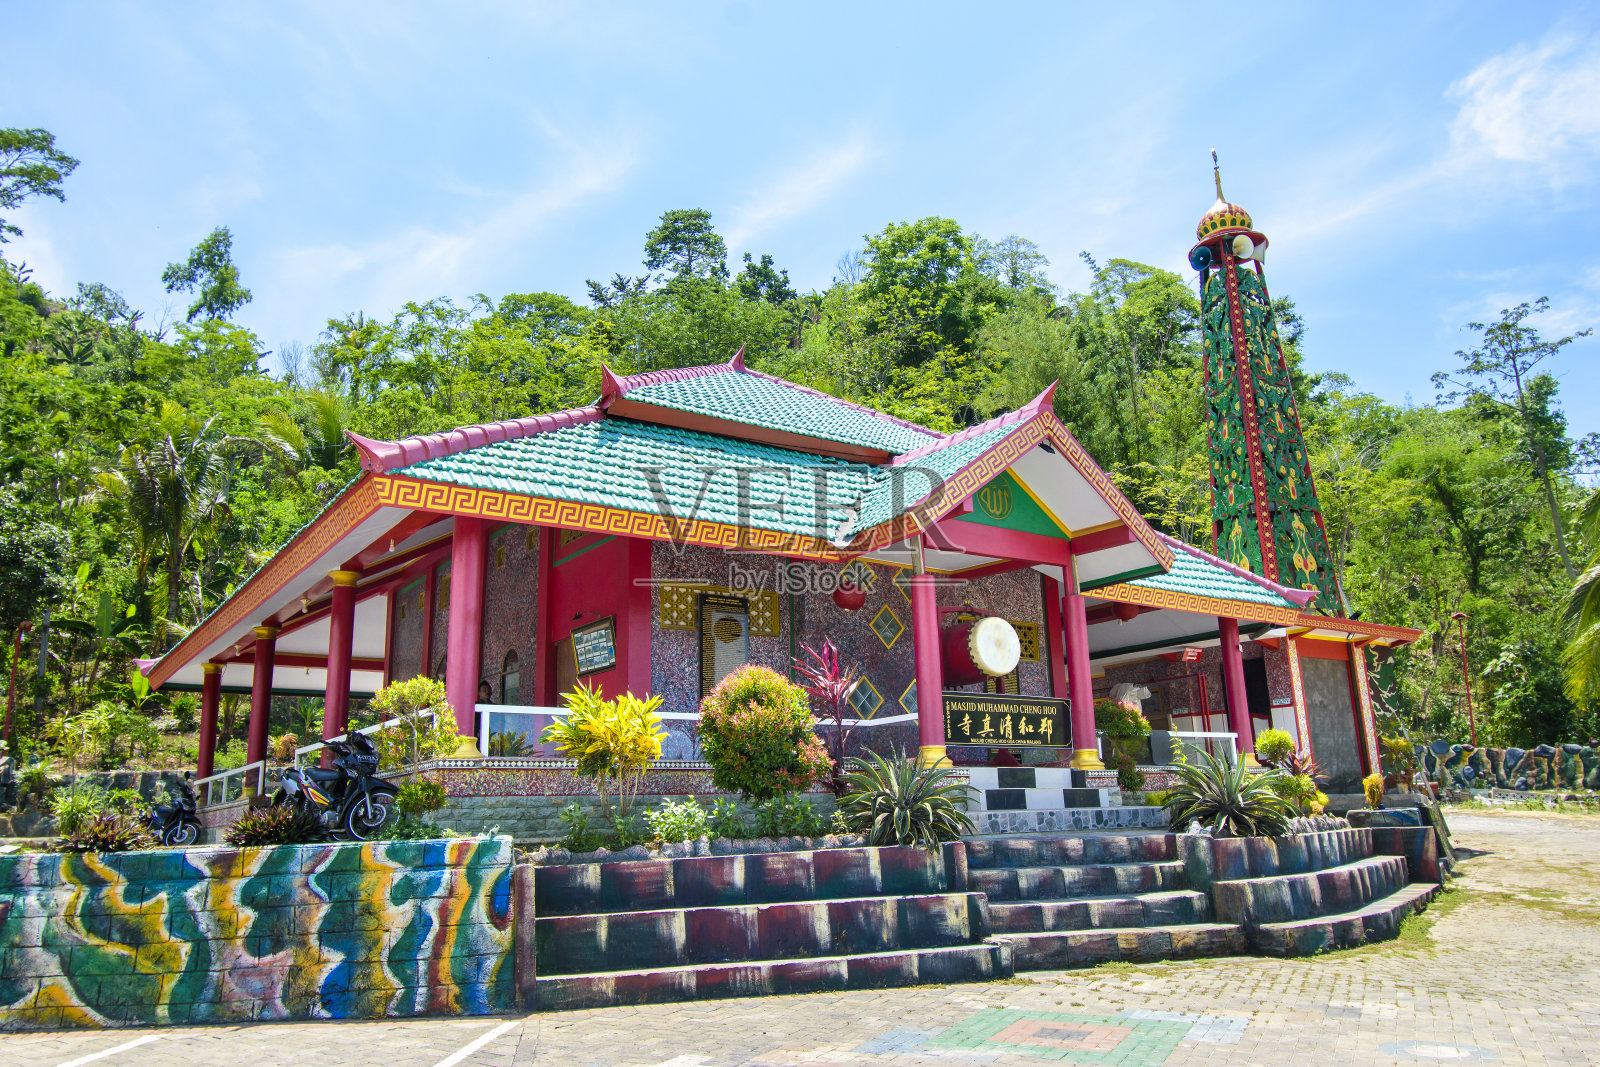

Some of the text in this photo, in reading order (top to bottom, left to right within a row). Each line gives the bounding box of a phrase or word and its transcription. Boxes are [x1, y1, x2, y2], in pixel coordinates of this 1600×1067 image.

[950, 701, 1057, 715] MASJID MUHAMMAD CHENG HOO
